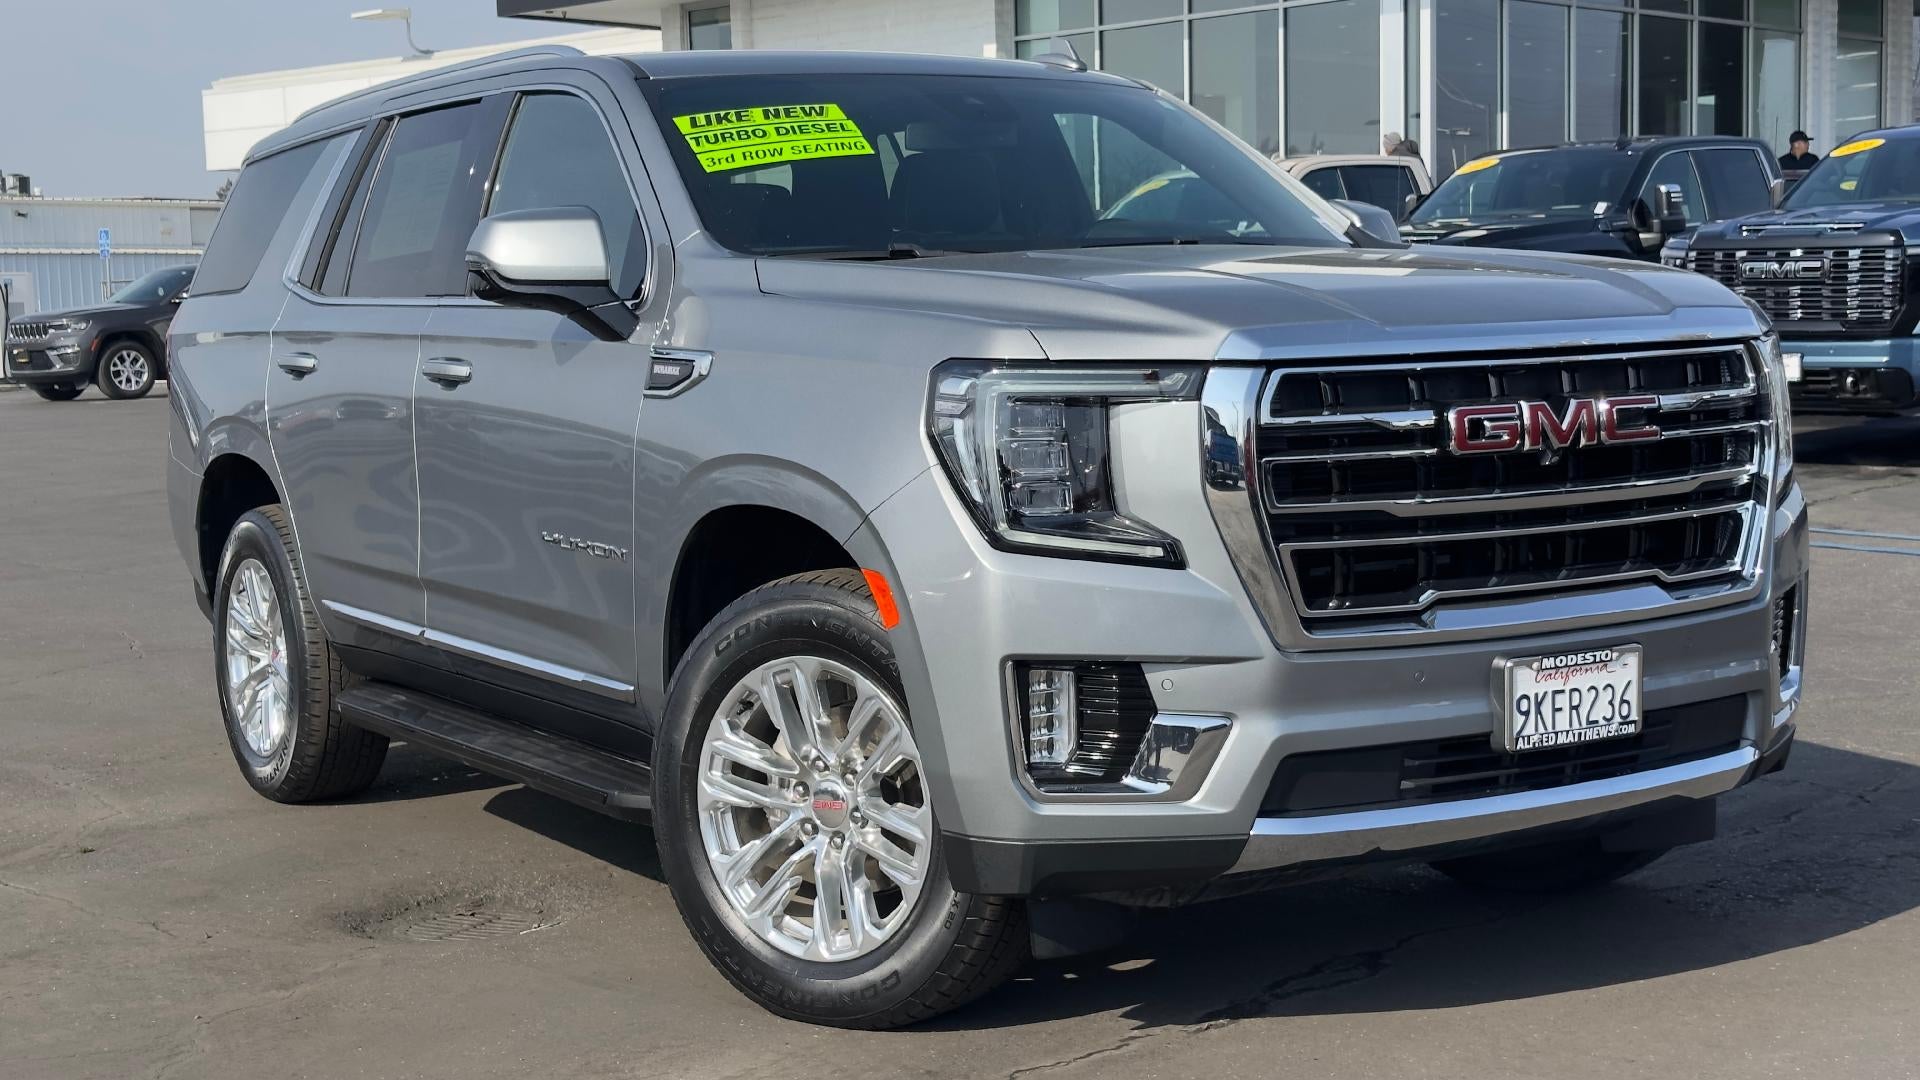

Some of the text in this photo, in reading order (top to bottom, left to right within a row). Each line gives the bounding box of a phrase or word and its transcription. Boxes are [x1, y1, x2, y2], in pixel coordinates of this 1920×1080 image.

[689, 105, 827, 129] LIKE NEW
[689, 121, 853, 147] TURBO DIESEL
[705, 140, 866, 168] 3rd ROW SEATING
[1741, 260, 1822, 279] GMC
[1448, 395, 1661, 455] GMC
[542, 531, 628, 561] YUKON
[1541, 650, 1612, 670] MODESTO
[1515, 679, 1633, 737] 9KFR236
